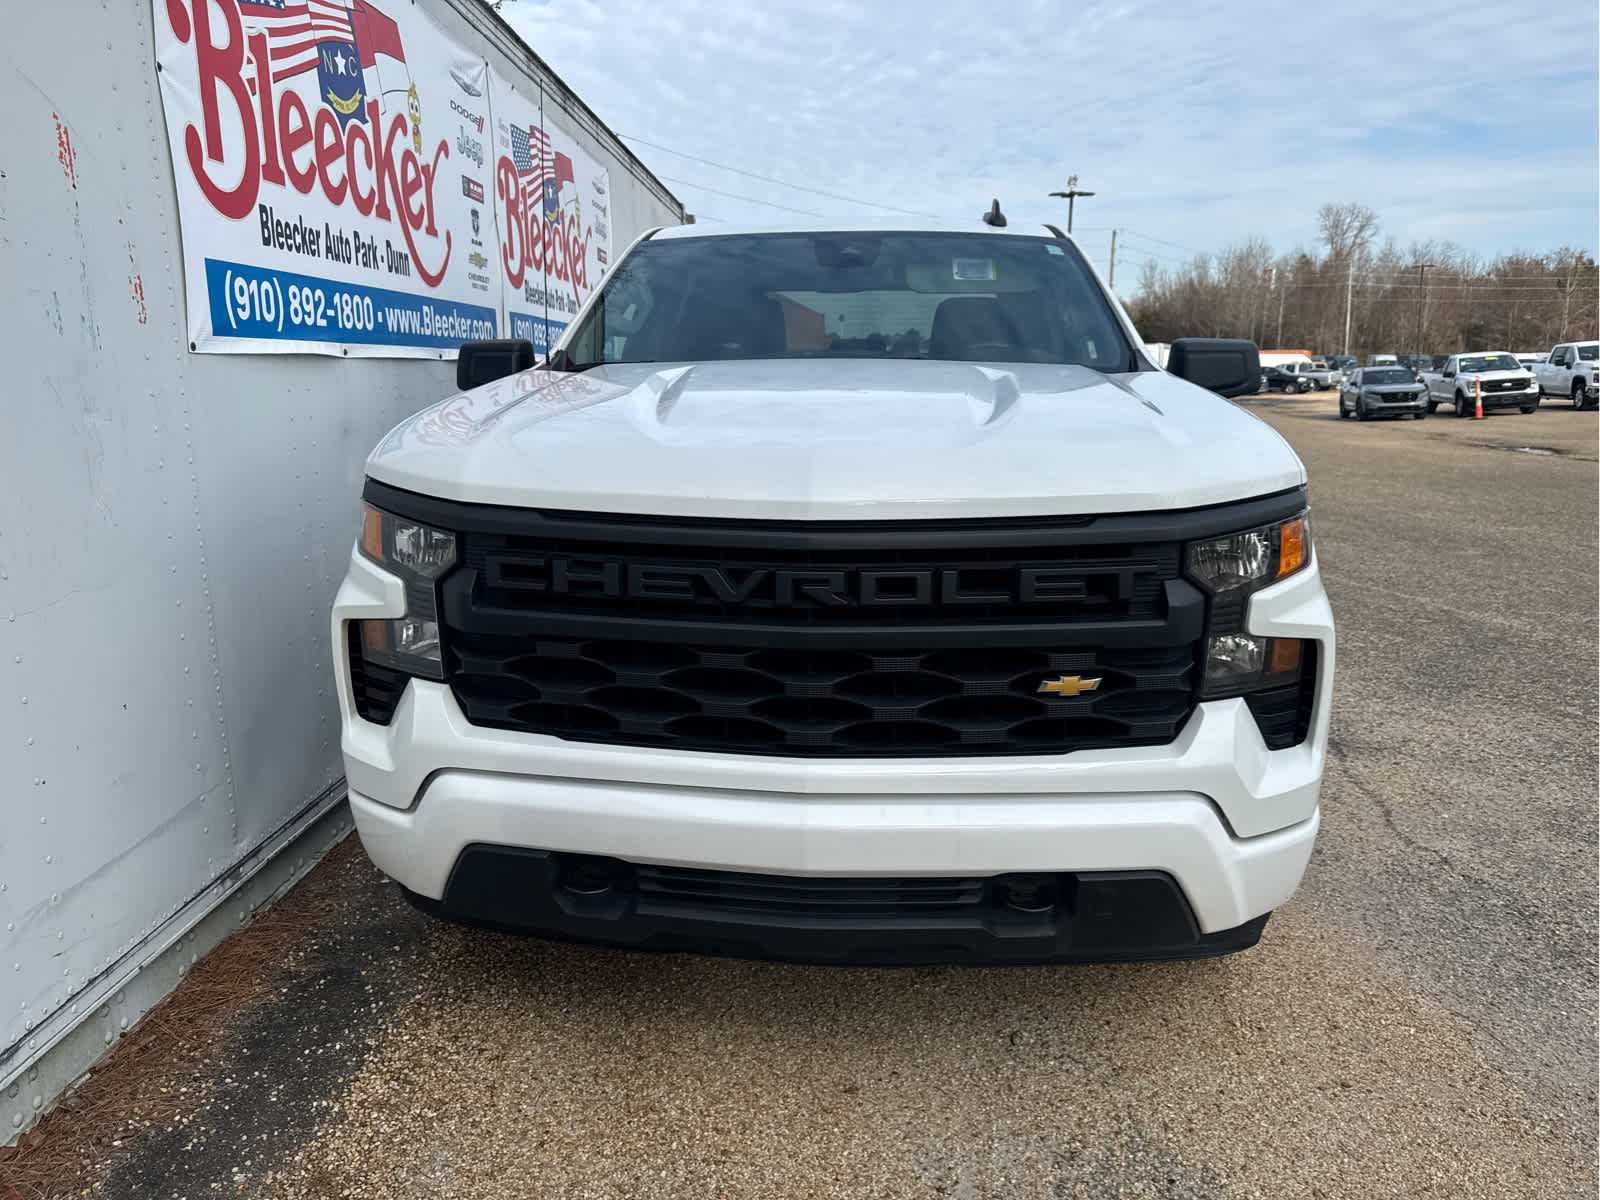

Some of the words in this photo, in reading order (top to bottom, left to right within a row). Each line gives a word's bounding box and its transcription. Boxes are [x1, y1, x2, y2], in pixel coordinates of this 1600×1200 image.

[322, 48, 334, 75] N
[348, 56, 358, 77] C
[166, 0, 452, 287] Bleecker
[450, 99, 482, 129] DODGE
[457, 125, 484, 169] Jeep
[258, 203, 321, 258] Bleecker
[325, 222, 352, 265] Auto
[353, 230, 380, 270] Park
[386, 240, 411, 276] Dunn
[497, 155, 594, 308] Bleecker
[225, 269, 284, 332] (910)
[288, 284, 375, 331] 892-1800
[385, 305, 494, 340] www.Bleecker.com
[486, 553, 1159, 607] CHEVROLET
